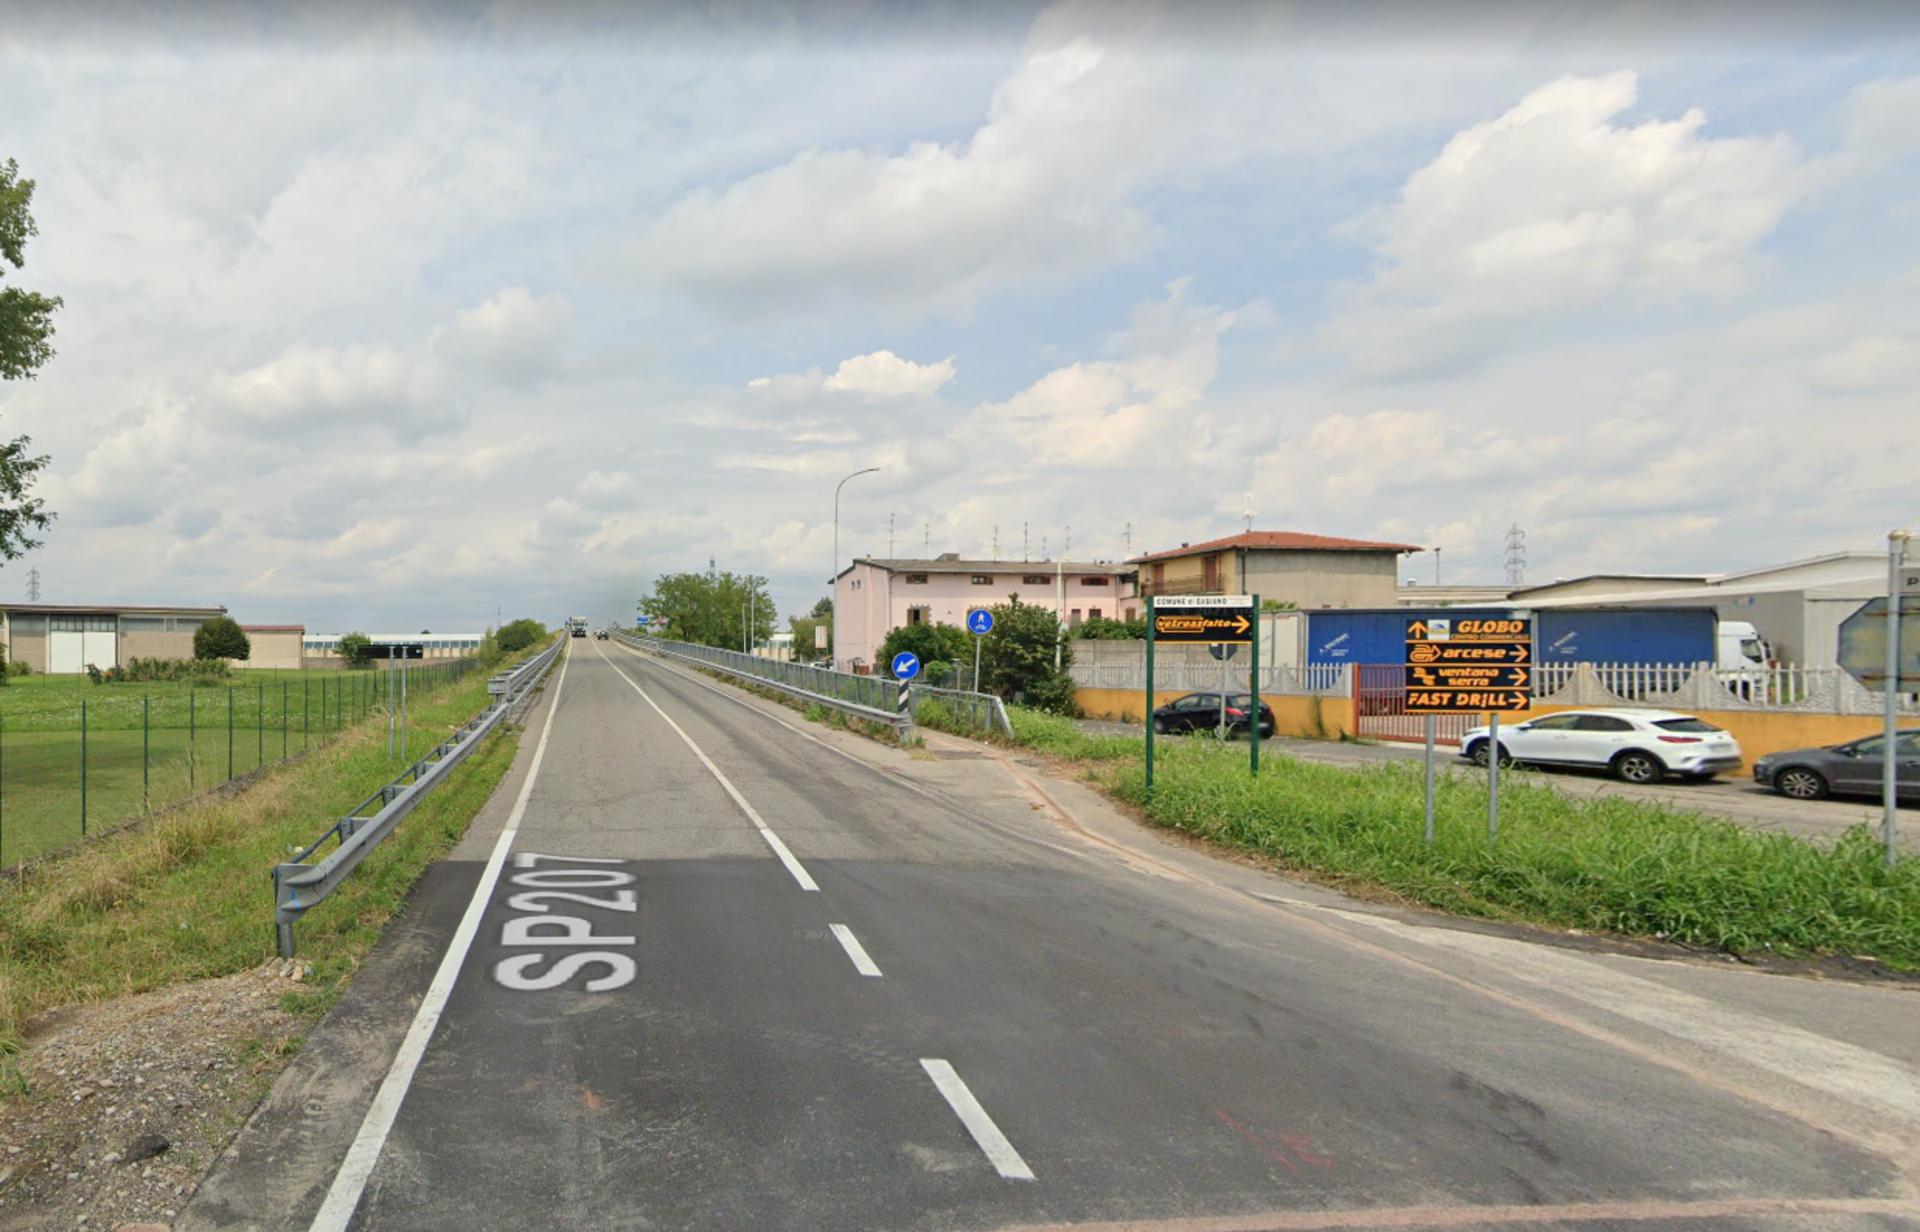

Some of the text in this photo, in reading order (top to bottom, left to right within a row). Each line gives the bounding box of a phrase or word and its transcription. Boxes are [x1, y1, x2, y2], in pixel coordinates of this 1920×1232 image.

[1458, 620, 1524, 633] GLOBO
[1443, 648, 1507, 658] arcese
[1438, 668, 1499, 677] ventana
[1448, 678, 1489, 686] serra
[1408, 693, 1452, 705] FAST
[495, 852, 638, 992] SP207
